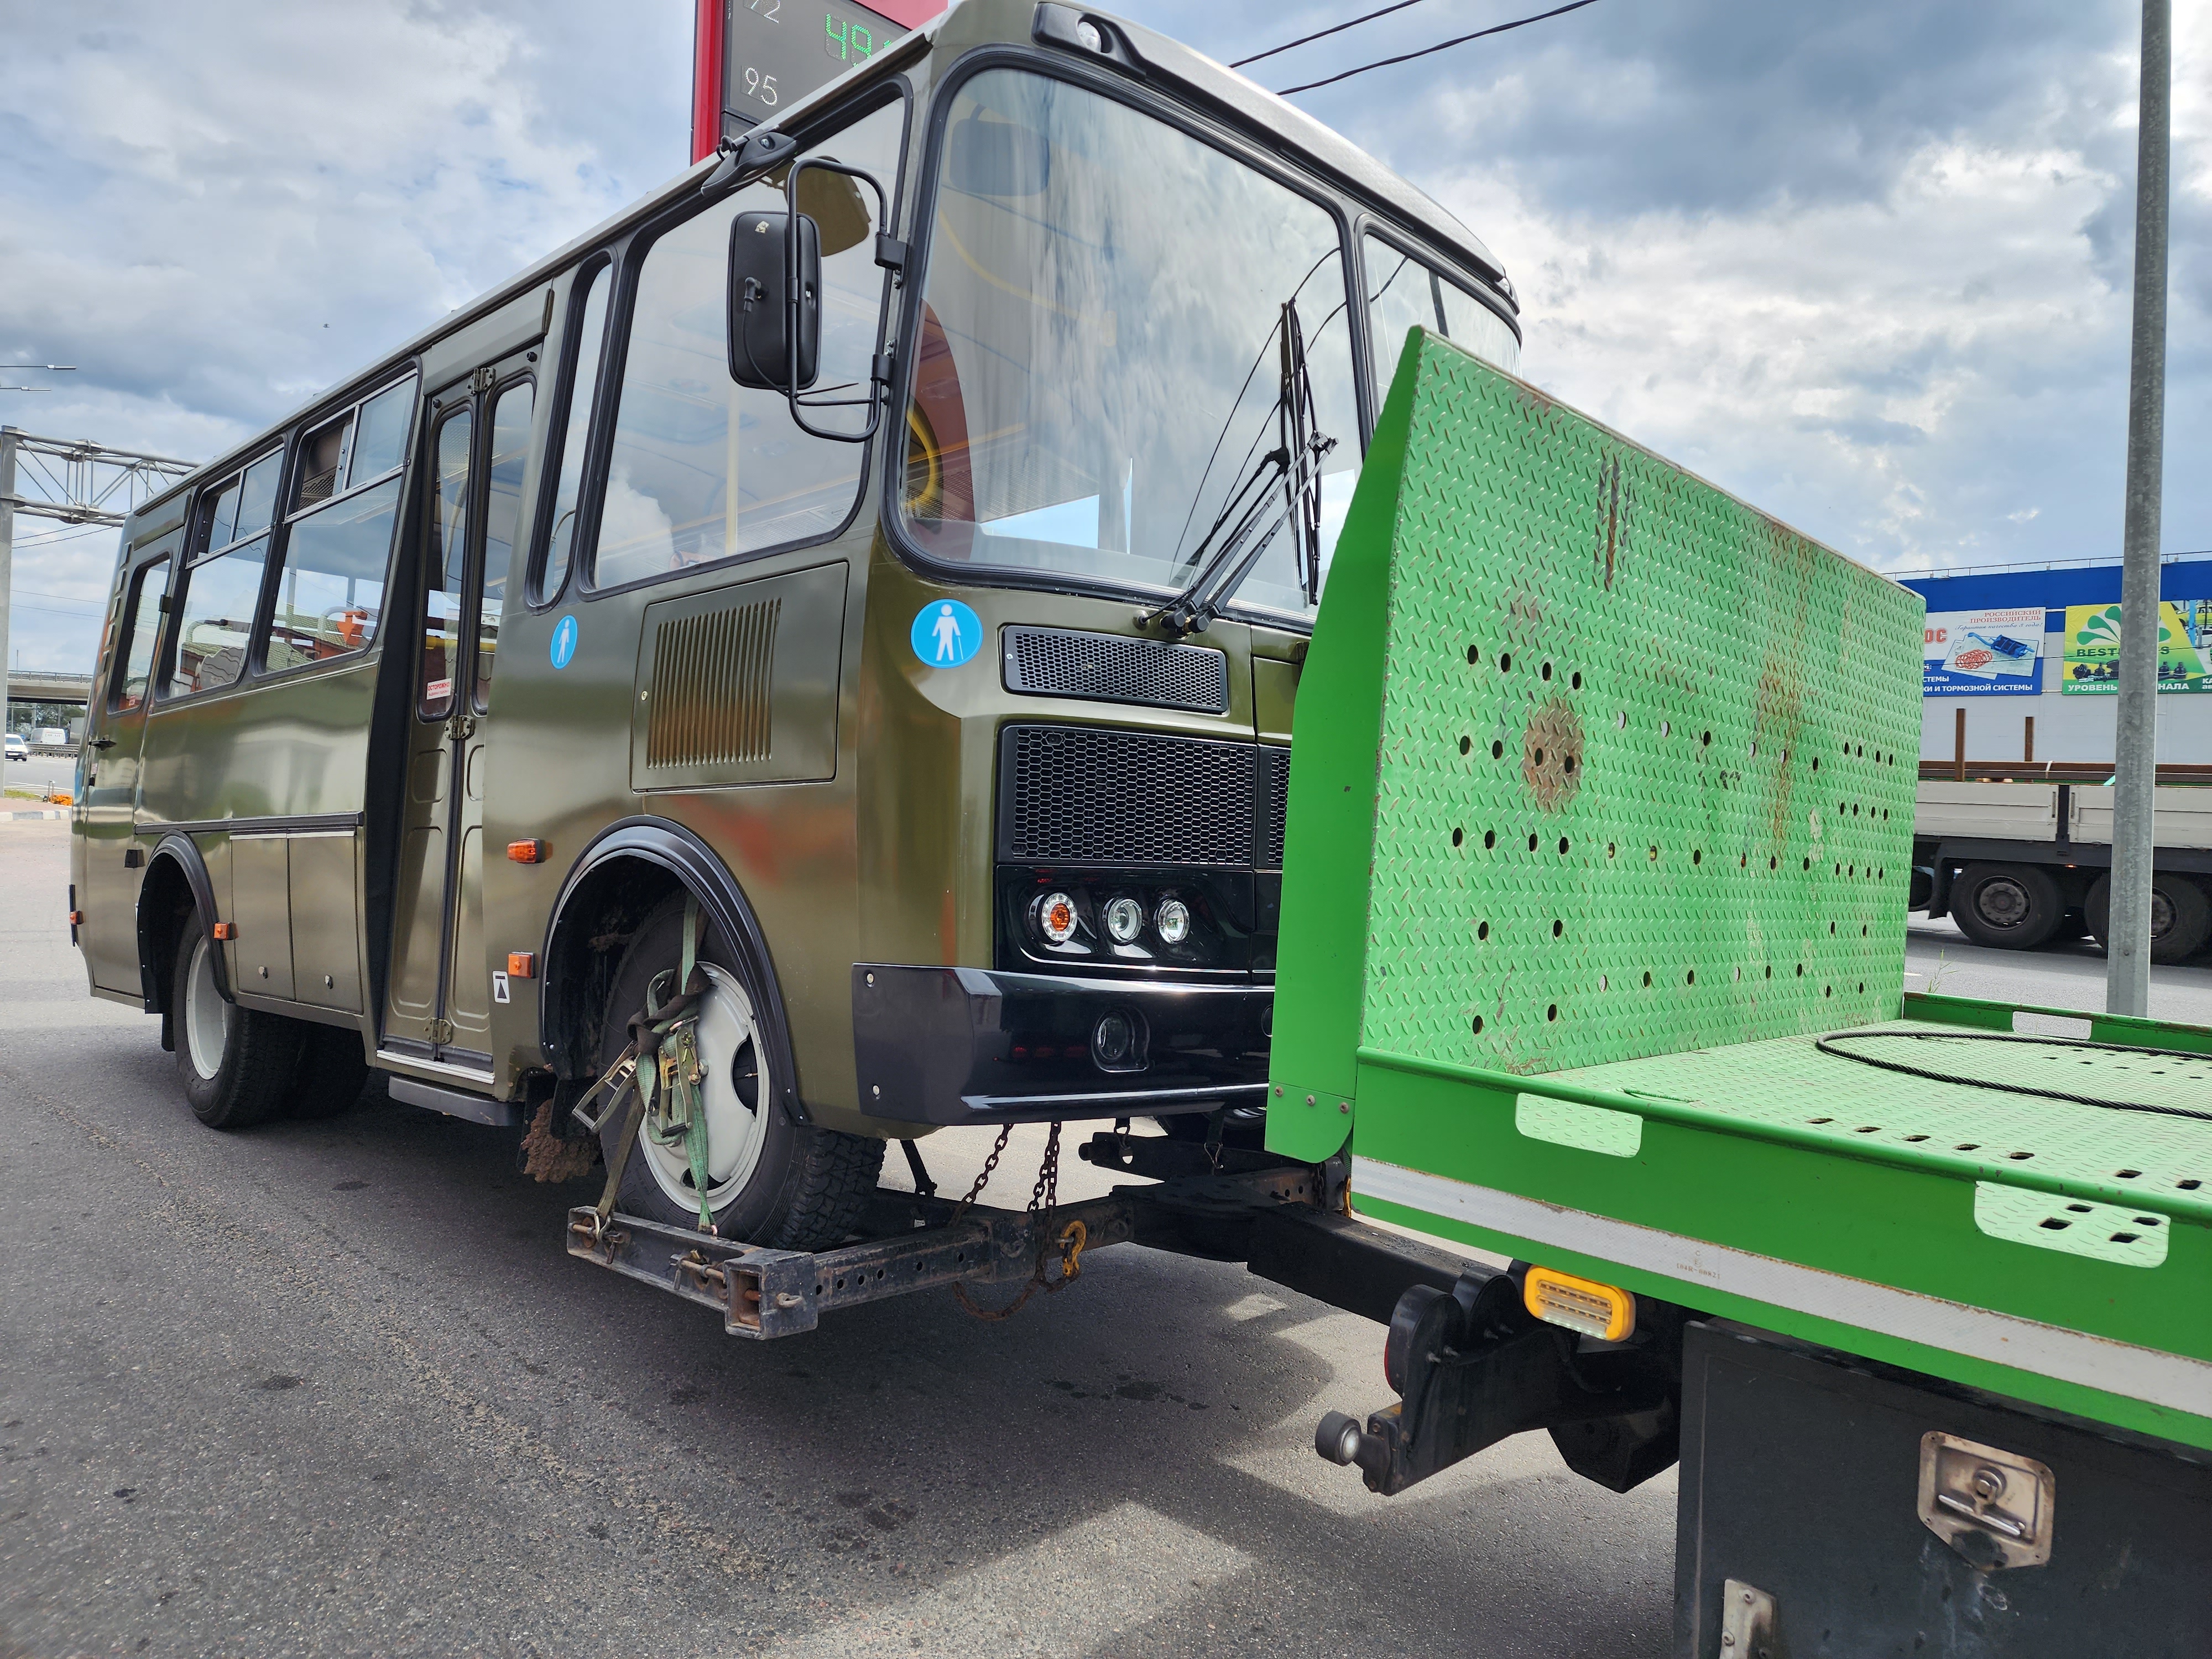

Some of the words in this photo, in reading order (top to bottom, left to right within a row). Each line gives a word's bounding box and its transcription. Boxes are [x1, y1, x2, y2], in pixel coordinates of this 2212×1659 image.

[826, 13, 892, 67] 49
[745, 67, 778, 106] 95
[1984, 609, 2041, 617] РОССИЙСКИЙ
[1924, 628, 1947, 644] ОС
[1942, 684, 1991, 692] ТОРМОЗНОЙ
